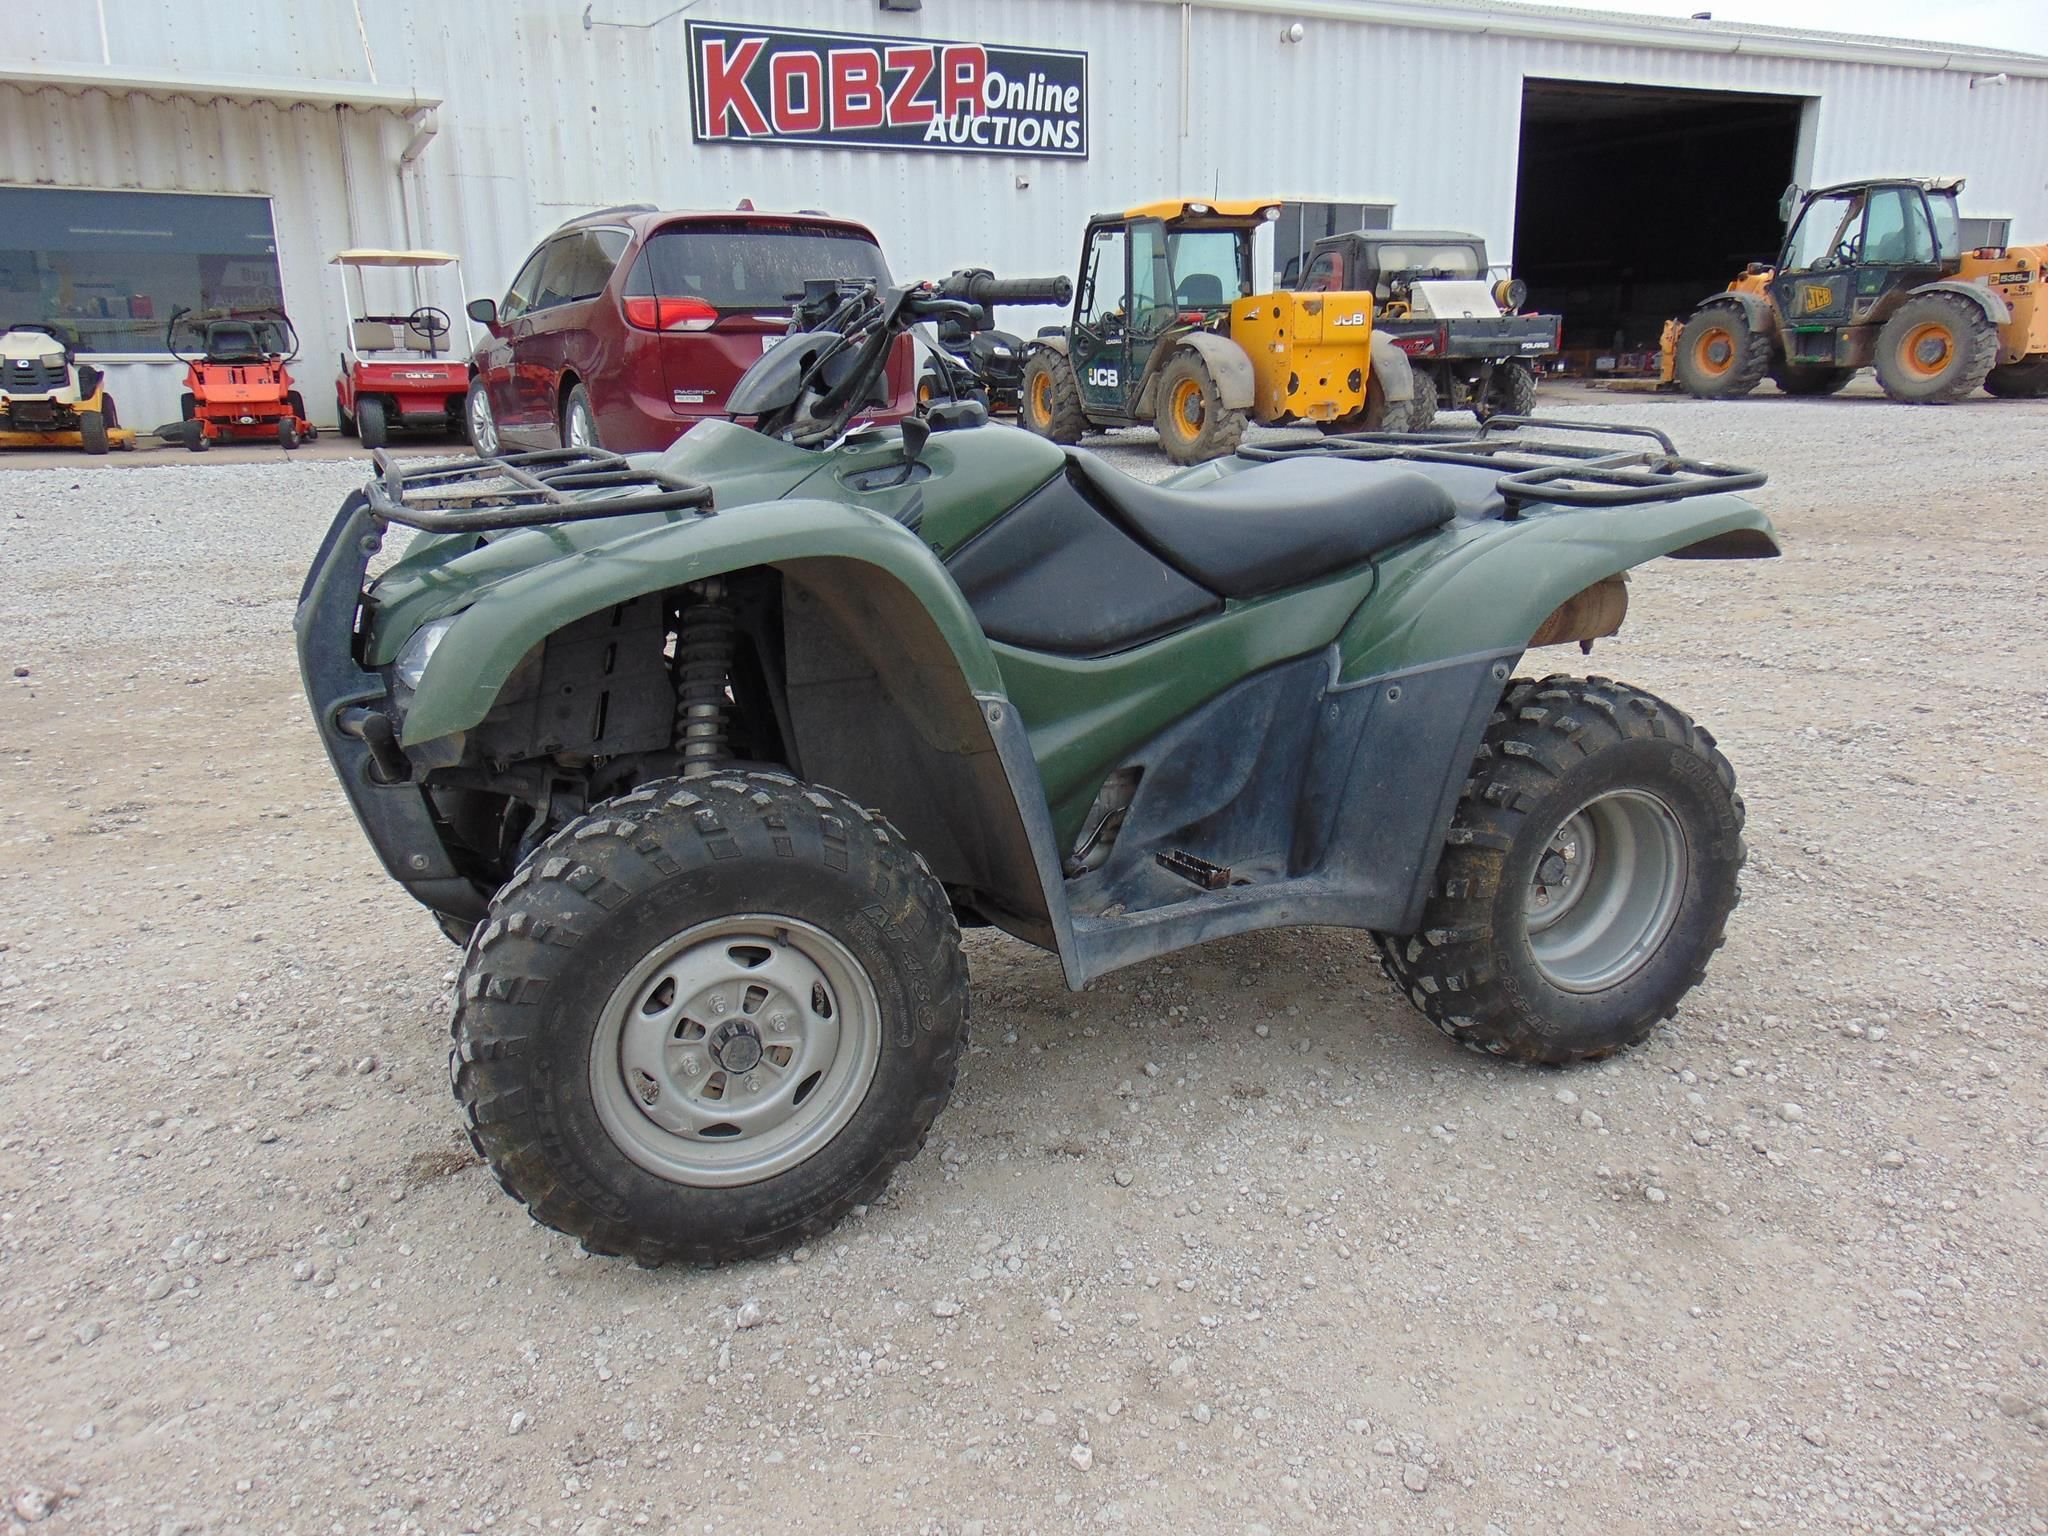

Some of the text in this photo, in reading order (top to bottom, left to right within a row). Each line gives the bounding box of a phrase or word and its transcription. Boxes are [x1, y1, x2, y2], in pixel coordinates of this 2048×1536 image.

[701, 37, 1080, 138] KOBZA Online
[924, 113, 1081, 149] AUCTIONS
[1807, 288, 1830, 310] JCB
[1333, 313, 1365, 326] JCB
[1521, 342, 1550, 350] POLARIS
[1088, 368, 1119, 388] JCB
